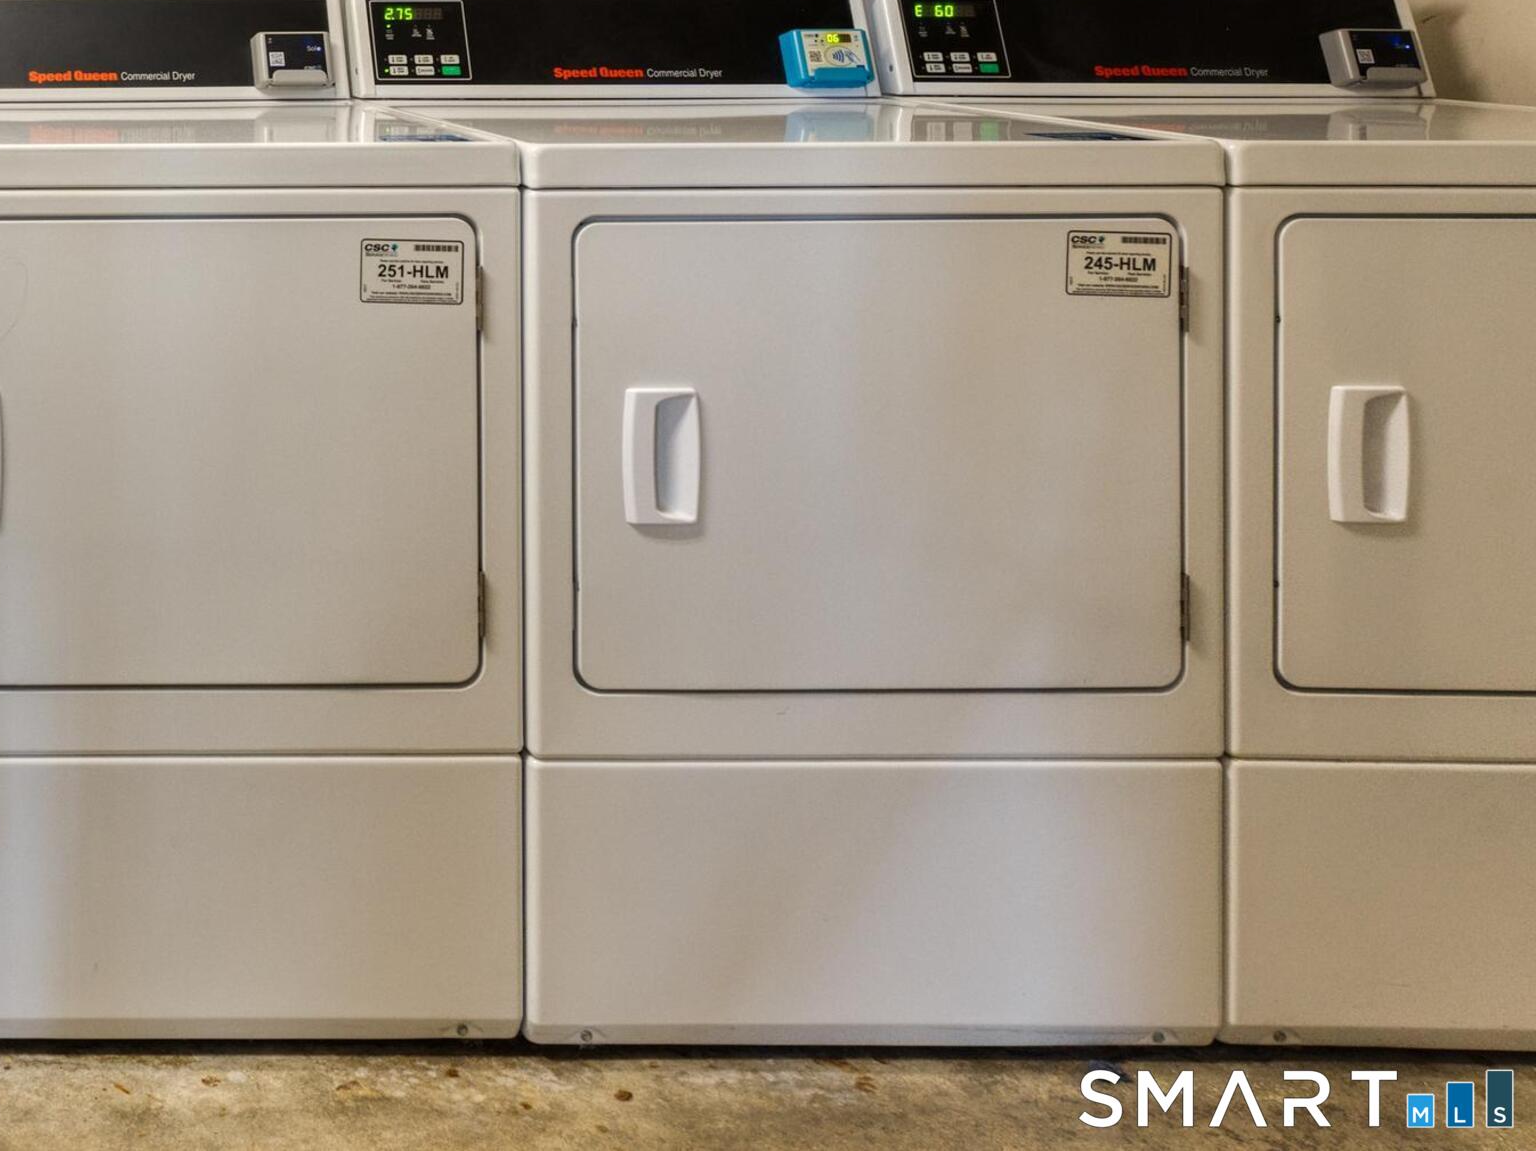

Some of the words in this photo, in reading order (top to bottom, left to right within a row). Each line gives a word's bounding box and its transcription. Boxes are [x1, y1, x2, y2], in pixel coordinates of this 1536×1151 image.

[384, 7, 413, 20] 2.75
[914, 4, 923, 17] E
[934, 4, 954, 18] 60
[825, 33, 840, 43] 06
[28, 70, 73, 84] Speed
[75, 70, 119, 83] Queen
[120, 71, 170, 82] Commercial
[172, 71, 196, 83] Dryer
[553, 67, 597, 80] Speed
[599, 67, 644, 79] Queen
[646, 68, 697, 79] Commercial
[699, 68, 723, 80] Dryer
[1094, 65, 1139, 78] Speed
[1141, 65, 1187, 77] Queen
[1190, 66, 1243, 77] Commercial
[1245, 66, 1269, 78] Dryer
[1071, 235, 1097, 244] CSC
[364, 243, 390, 252] CSC
[1084, 256, 1156, 271] 245-HLM
[377, 264, 449, 279] 251-HLM
